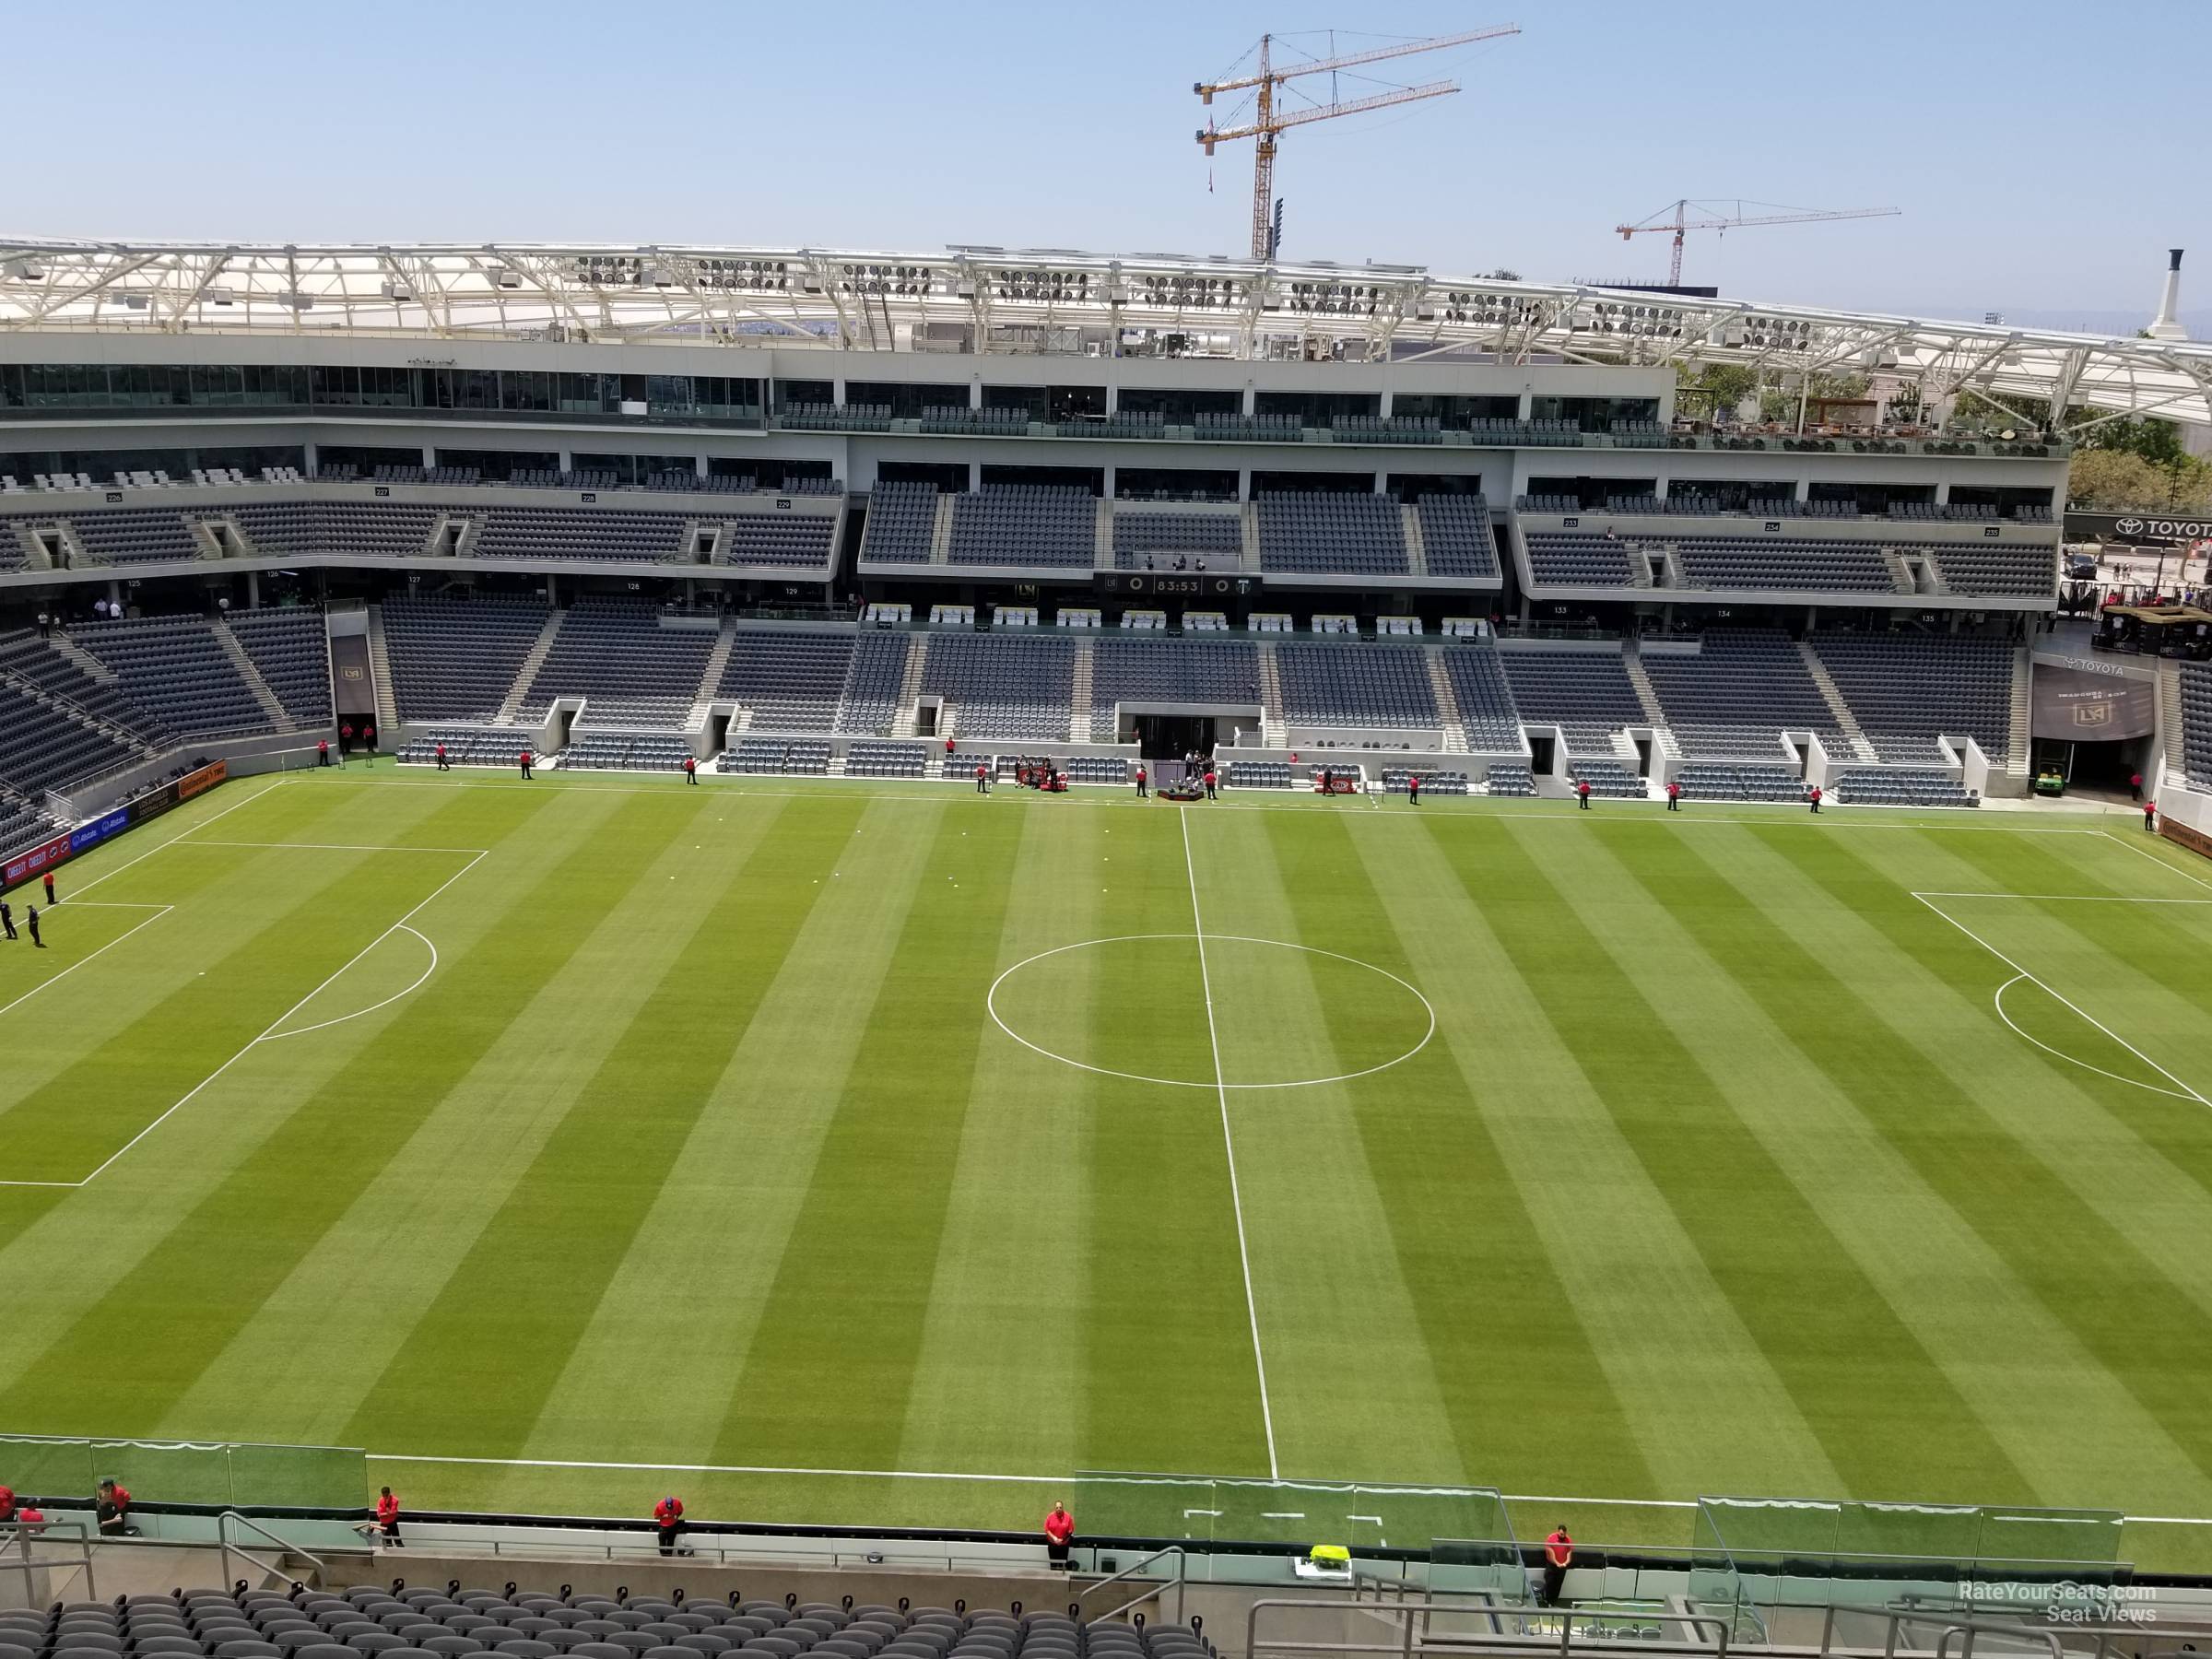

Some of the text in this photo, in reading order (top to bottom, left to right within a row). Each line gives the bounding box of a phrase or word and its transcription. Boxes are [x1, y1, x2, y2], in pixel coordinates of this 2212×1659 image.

[2147, 521, 2212, 536] TOYOT
[1129, 577, 1143, 590] 0
[1157, 582, 1198, 592] 83:53
[1215, 580, 1229, 592] 0
[2080, 661, 2124, 677] TOYOTA
